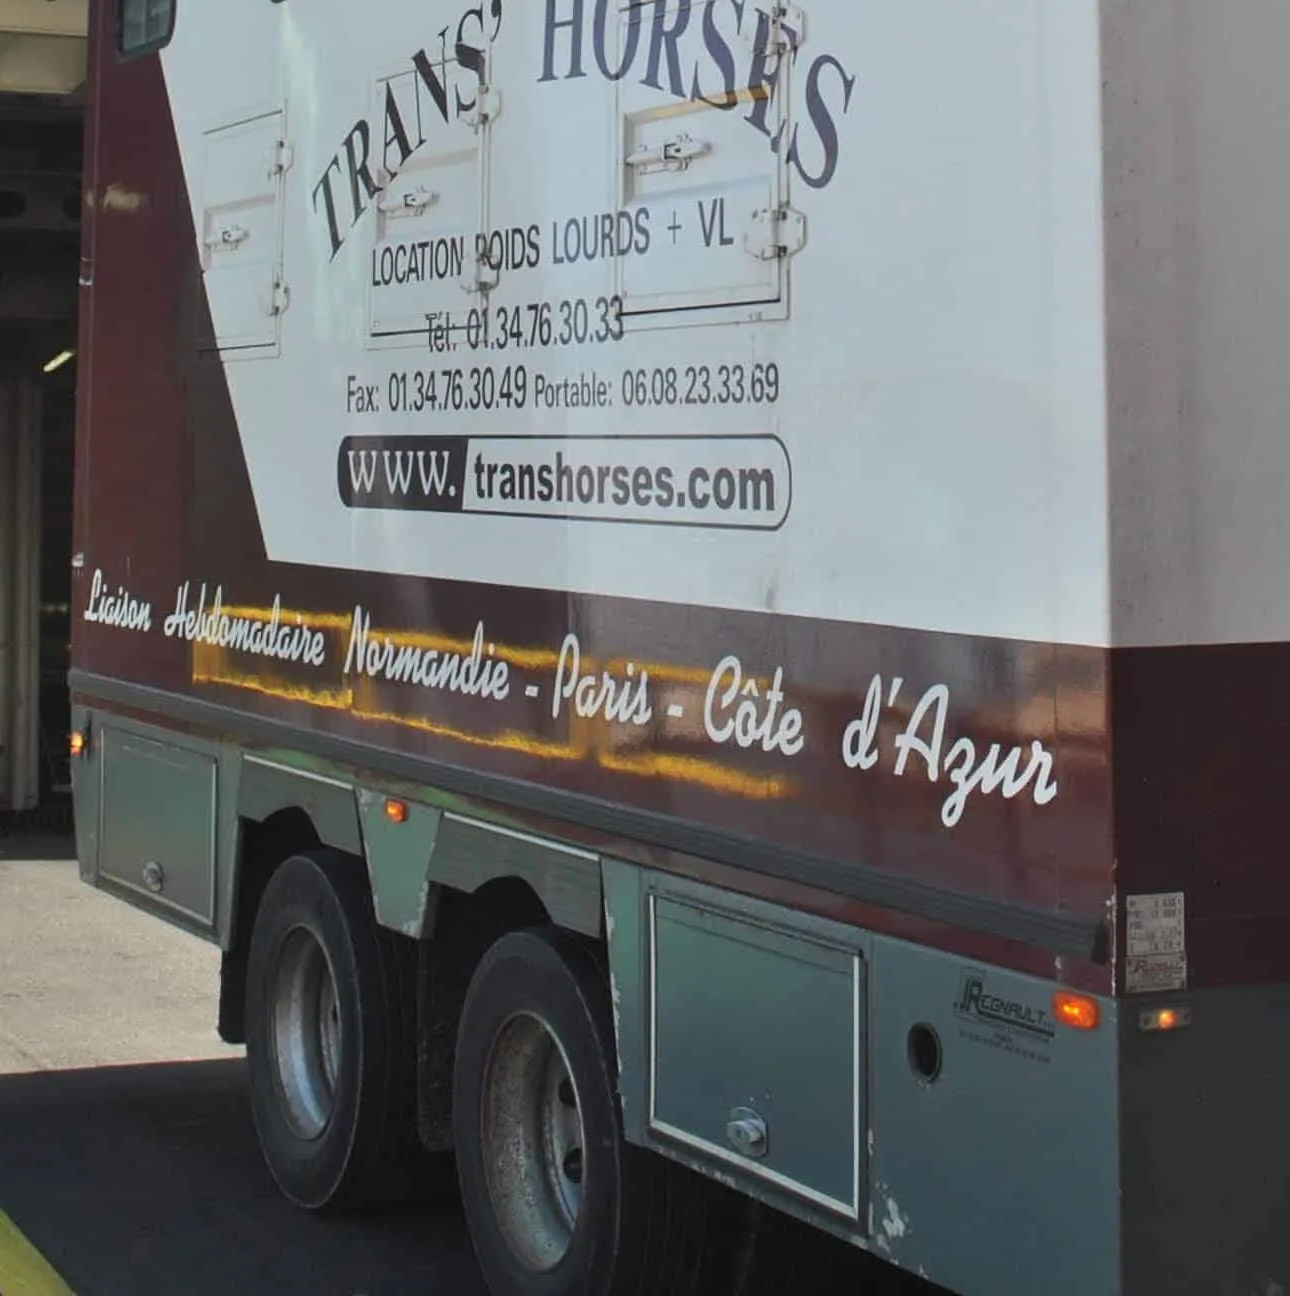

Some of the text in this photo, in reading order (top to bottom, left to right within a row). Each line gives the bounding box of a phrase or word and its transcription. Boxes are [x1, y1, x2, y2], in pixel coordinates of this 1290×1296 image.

[372, 198, 735, 287] LOCATION POIDS LOURDS + VL
[466, 295, 625, 351] 01.34.76.30.33
[346, 362, 780, 413] Fax: 01.34.76.30.49 Portable: 06.08.23.33.69
[84, 569, 153, 633] Liaison
[163, 580, 326, 666] Hebdomadaire
[343, 604, 511, 701] Normandie
[552, 633, 652, 725] Paris
[702, 654, 805, 756] Côte
[842, 673, 1058, 827] d'Azur
